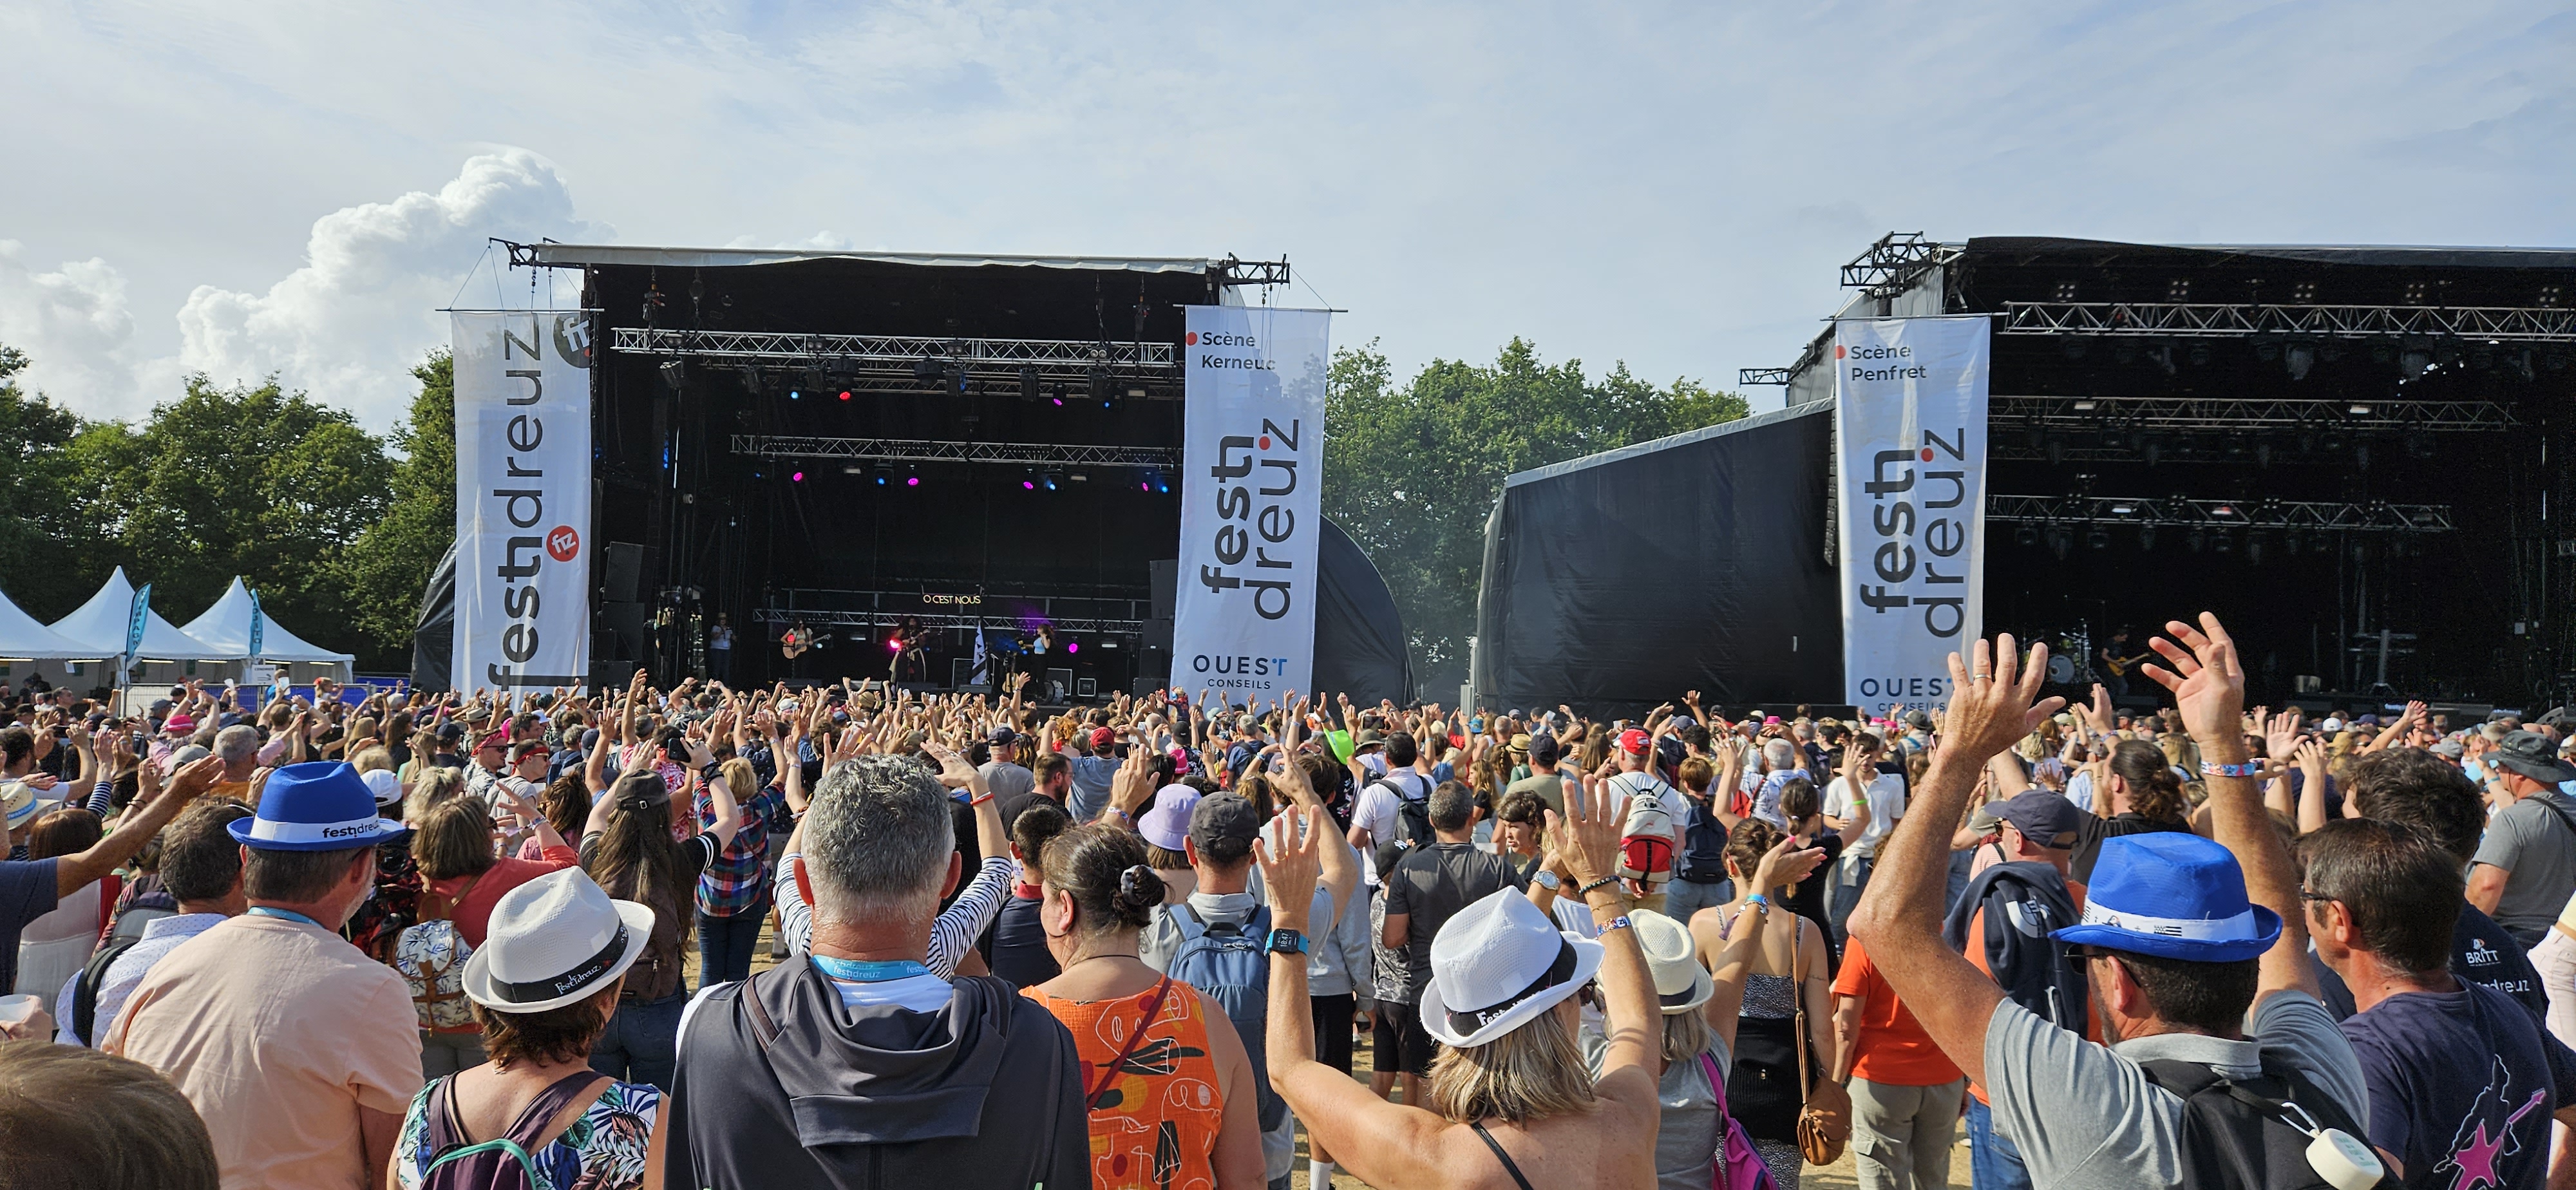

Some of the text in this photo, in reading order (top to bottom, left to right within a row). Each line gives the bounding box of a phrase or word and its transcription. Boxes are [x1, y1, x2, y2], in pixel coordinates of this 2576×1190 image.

[1202, 331, 1256, 347] Scène
[1851, 345, 1911, 359] Scène
[1202, 355, 1276, 370] Kerneuc
[1852, 365, 1927, 381] Penfret
[1244, 419, 1300, 620] dreuz
[1913, 428, 1965, 638] dreuz
[923, 594, 931, 603] O
[955, 595, 981, 604] NOUS
[252, 601, 261, 644] OJITO
[1193, 654, 1287, 676] OUEST
[1208, 679, 1271, 689] CONSEILS
[1860, 678, 1954, 697] OUES
